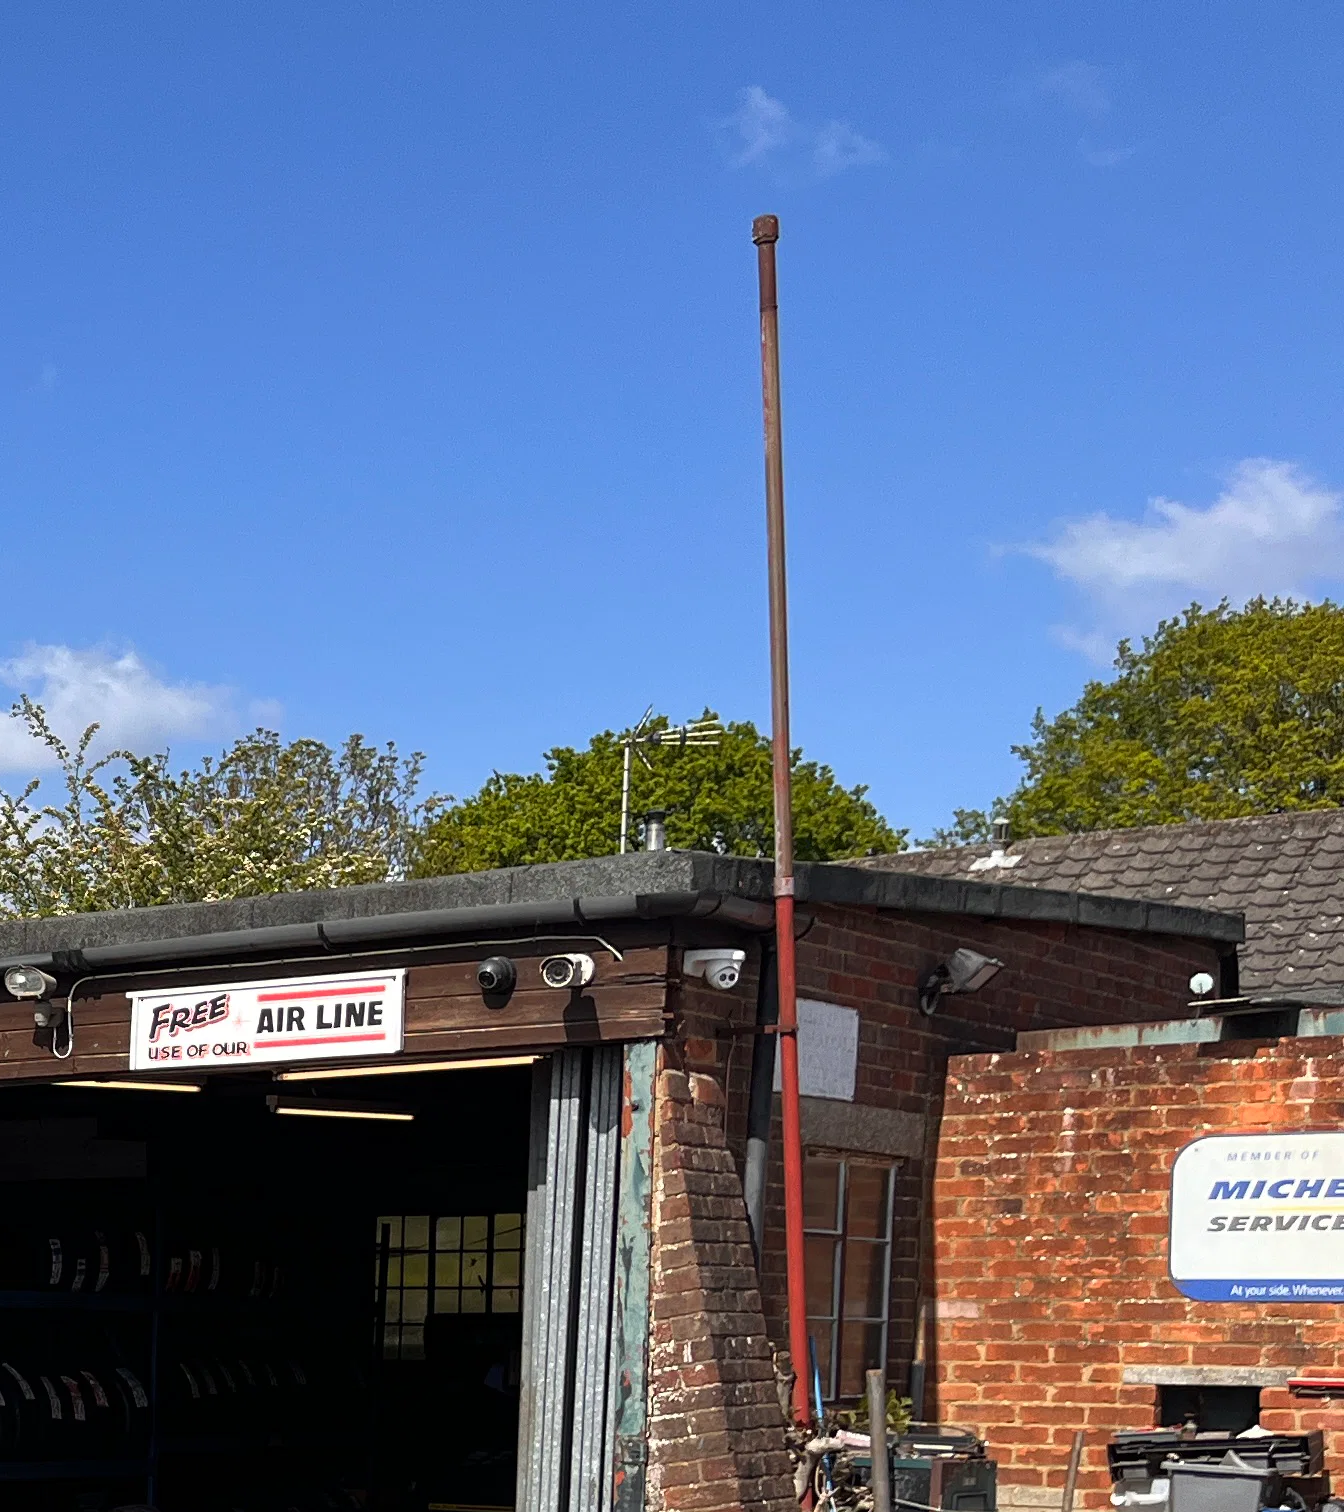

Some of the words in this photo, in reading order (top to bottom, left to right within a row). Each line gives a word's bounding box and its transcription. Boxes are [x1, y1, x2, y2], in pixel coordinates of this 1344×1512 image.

[149, 993, 230, 1042] FREE
[256, 1005, 305, 1034] AIR
[315, 1000, 383, 1030] LINE
[148, 1045, 181, 1060] USE
[186, 1043, 209, 1058] OF
[212, 1041, 250, 1057] OUR
[1227, 1151, 1292, 1161] MEMBER
[1300, 1150, 1319, 1160] OF
[1230, 1285, 1243, 1296] At
[1245, 1286, 1266, 1298] your
